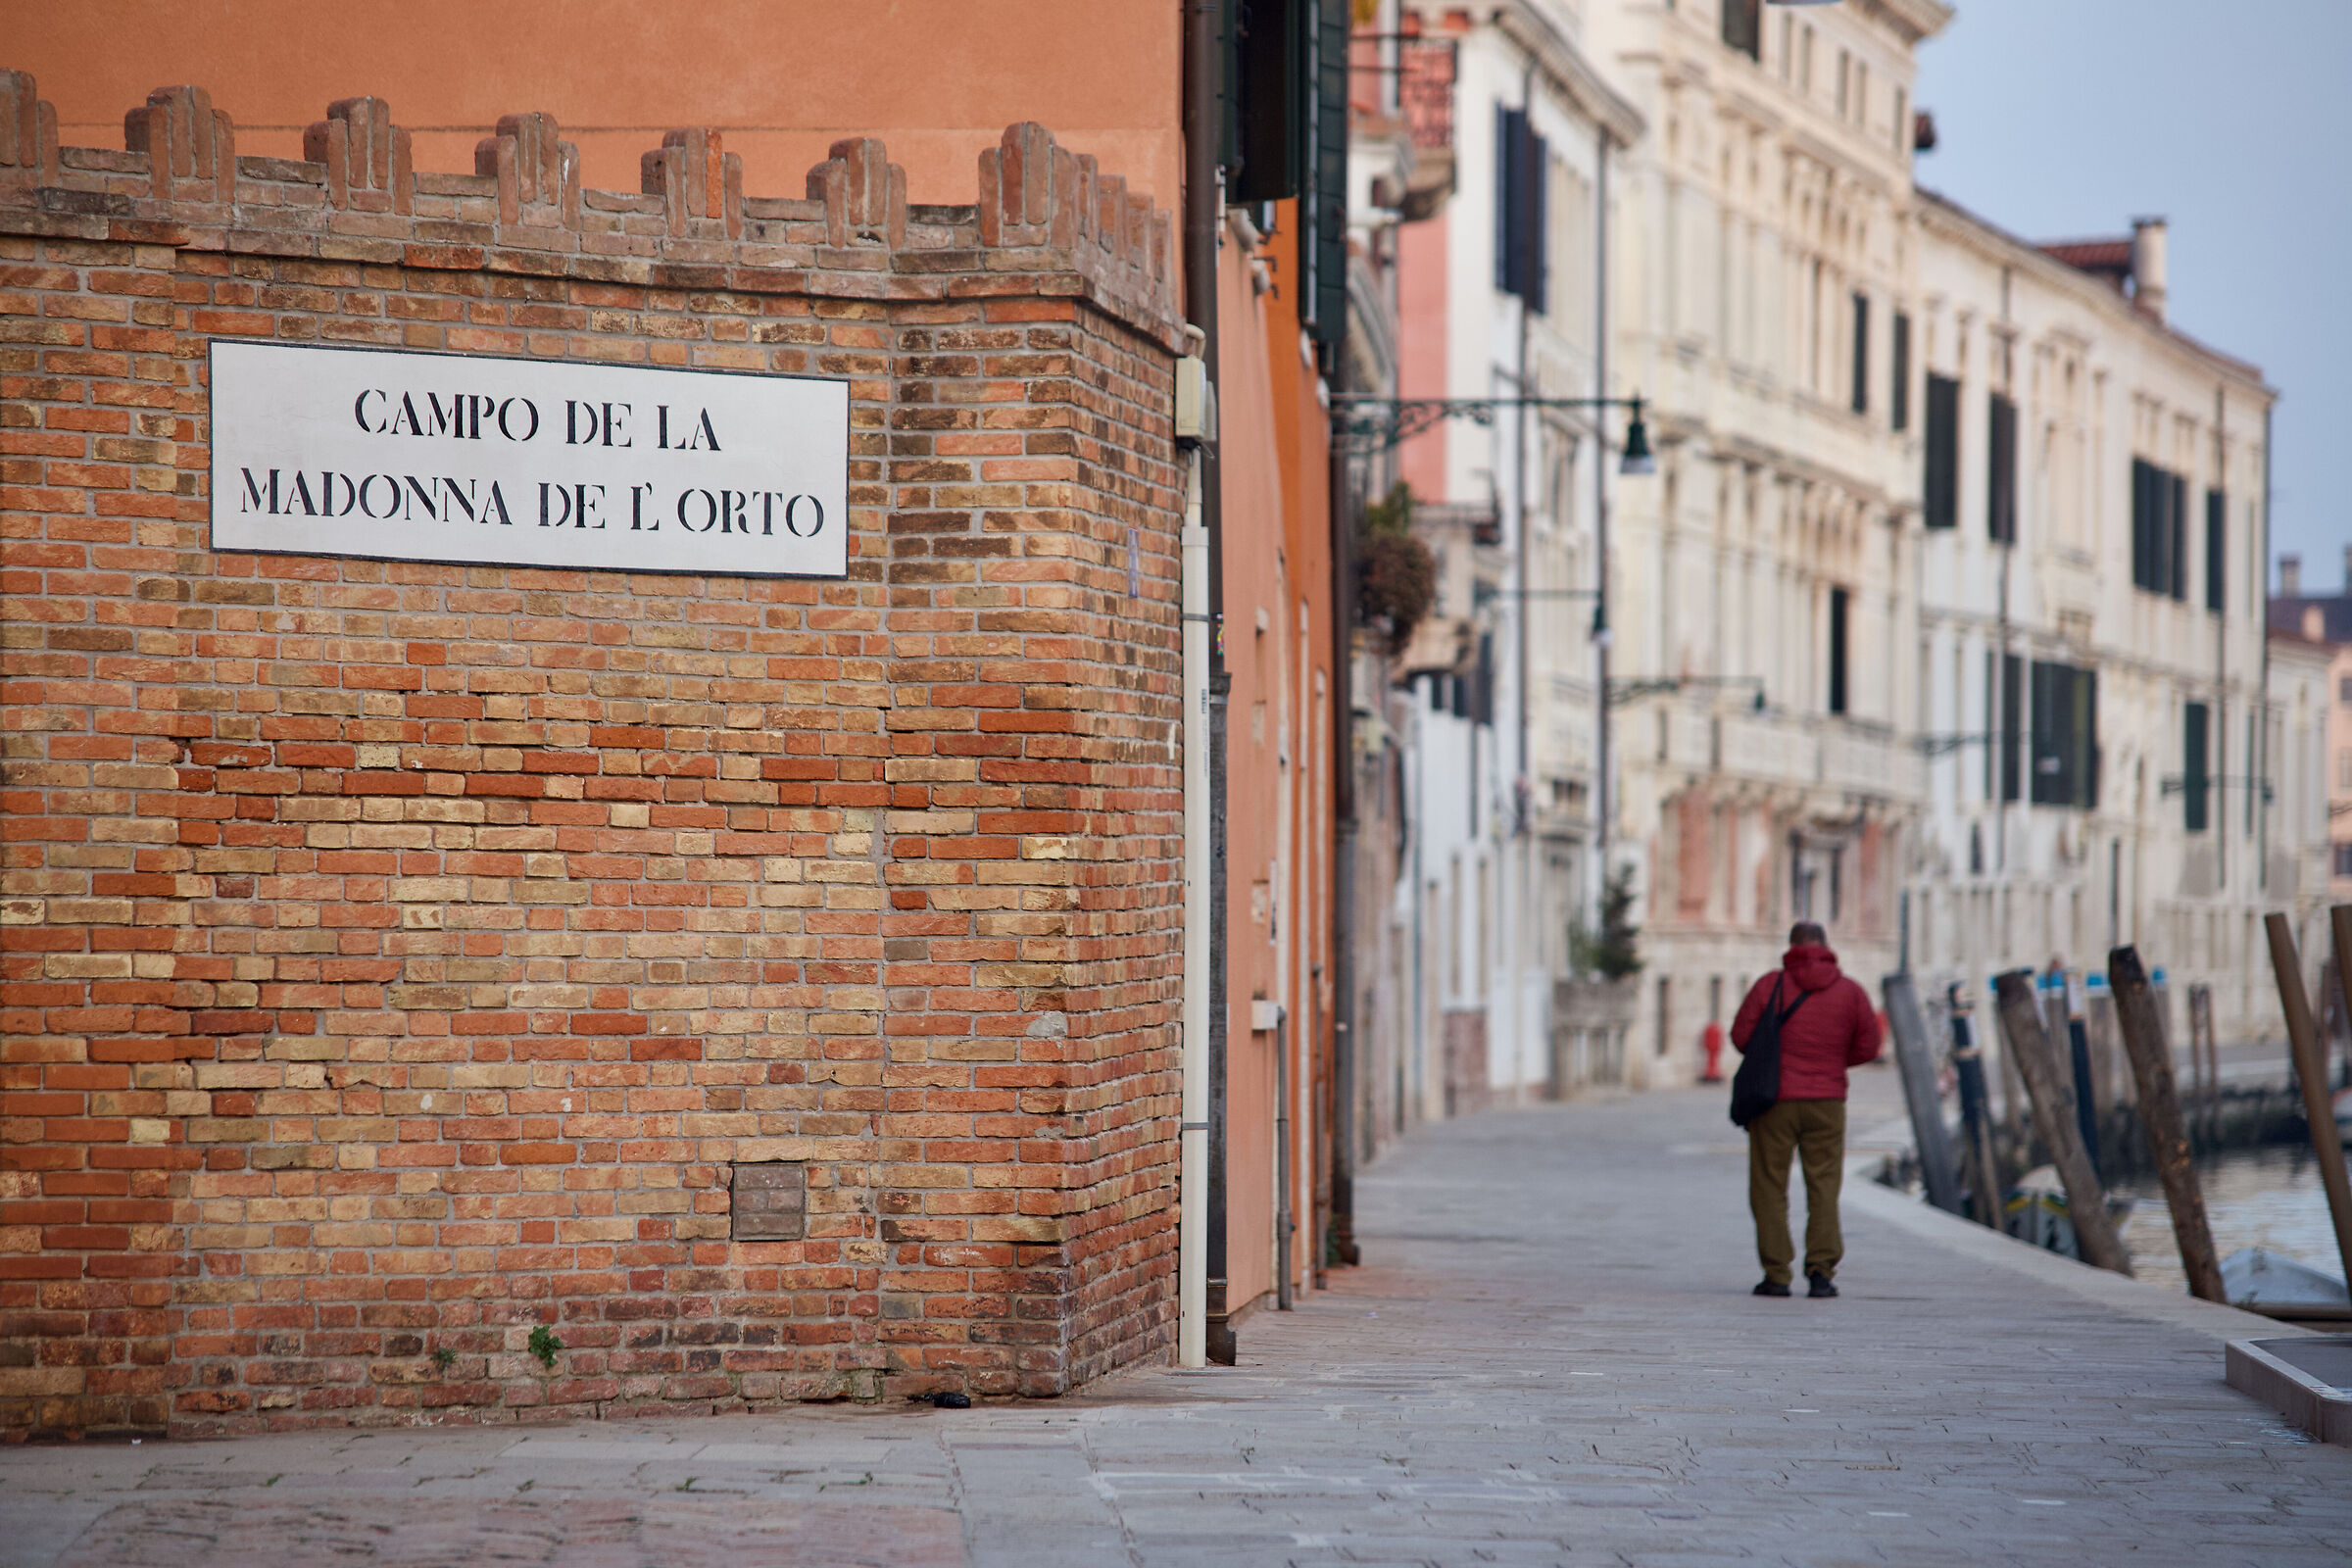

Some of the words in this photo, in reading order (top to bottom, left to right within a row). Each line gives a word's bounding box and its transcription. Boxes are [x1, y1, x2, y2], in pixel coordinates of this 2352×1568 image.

[355, 389, 540, 443] CAMPO
[565, 400, 632, 448] DE
[657, 405, 721, 452] LA
[240, 467, 514, 525] MADONNA
[538, 482, 606, 530] DE
